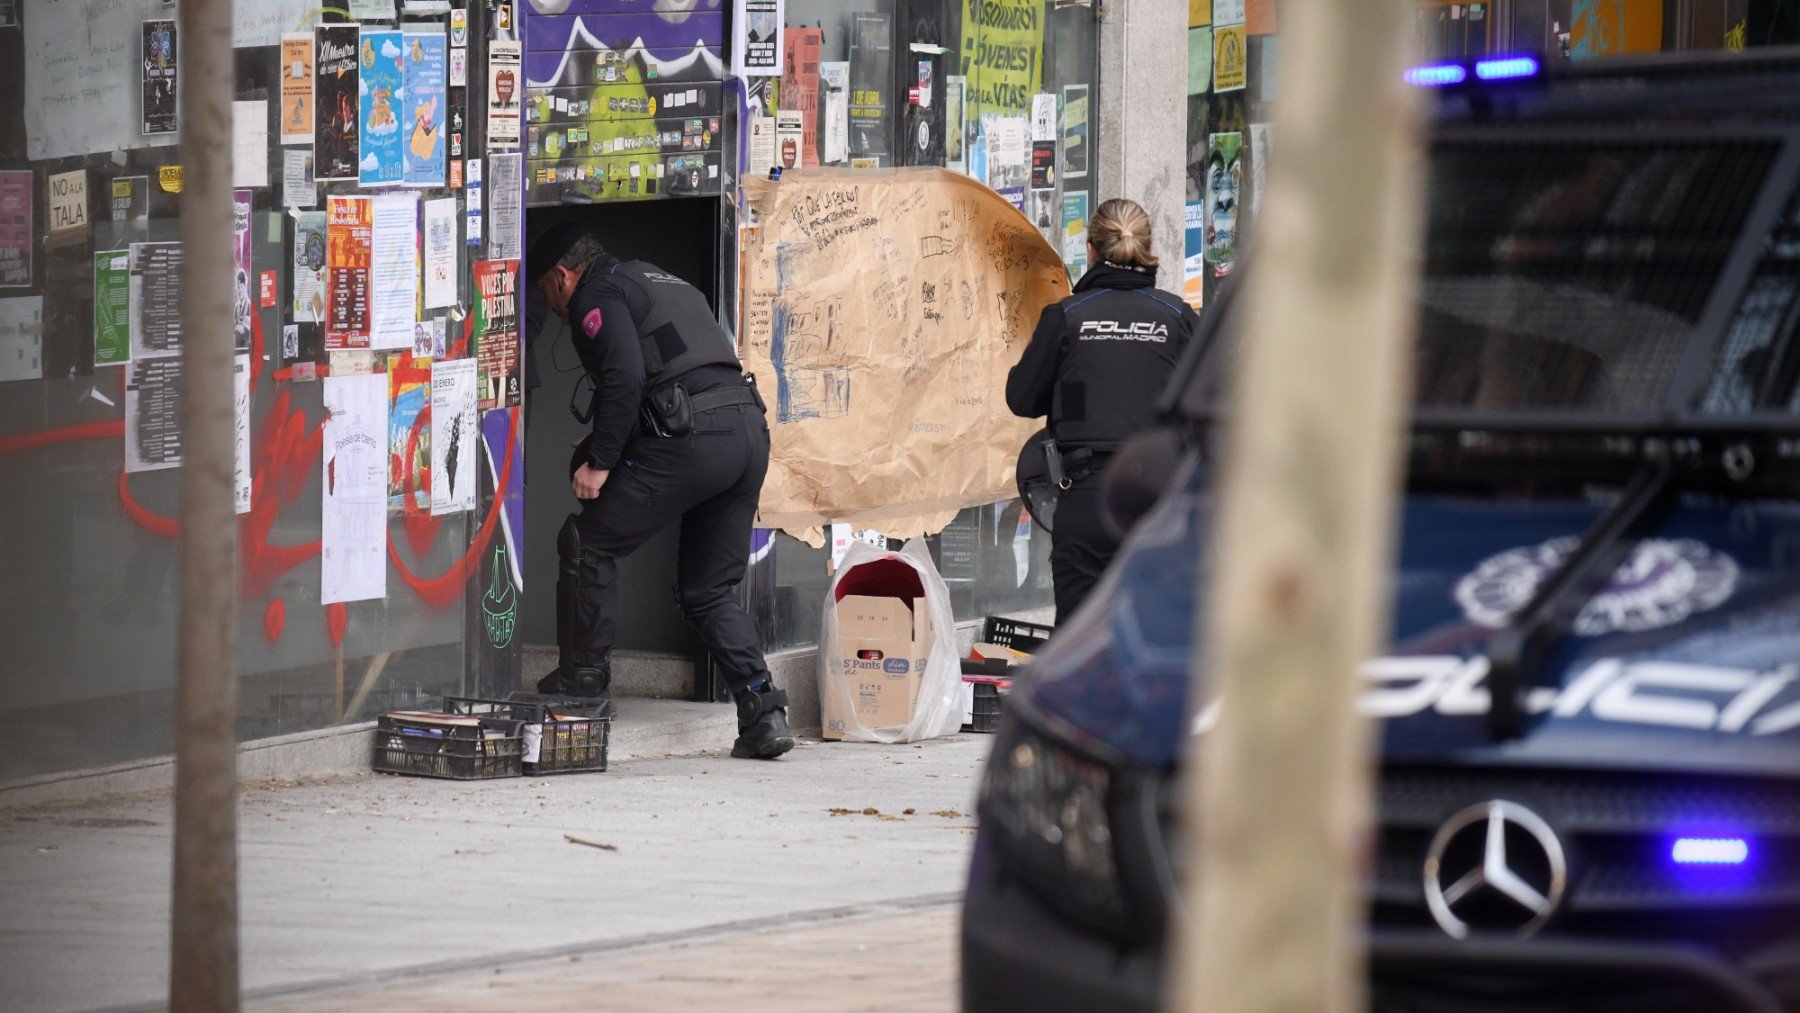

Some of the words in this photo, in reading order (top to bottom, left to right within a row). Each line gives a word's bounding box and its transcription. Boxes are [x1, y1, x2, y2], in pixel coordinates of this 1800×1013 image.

[52, 178, 68, 197] NO
[70, 185, 75, 194] A
[75, 183, 83, 194] LA
[54, 203, 84, 228] TALA
[481, 273, 501, 296] VOCES
[502, 271, 515, 294] POR
[481, 294, 515, 320] PALESTINA
[1080, 320, 1169, 336] POLICÍA
[1122, 334, 1167, 343] MADRID
[853, 660, 881, 670] Pants
[827, 719, 846, 732] 80
